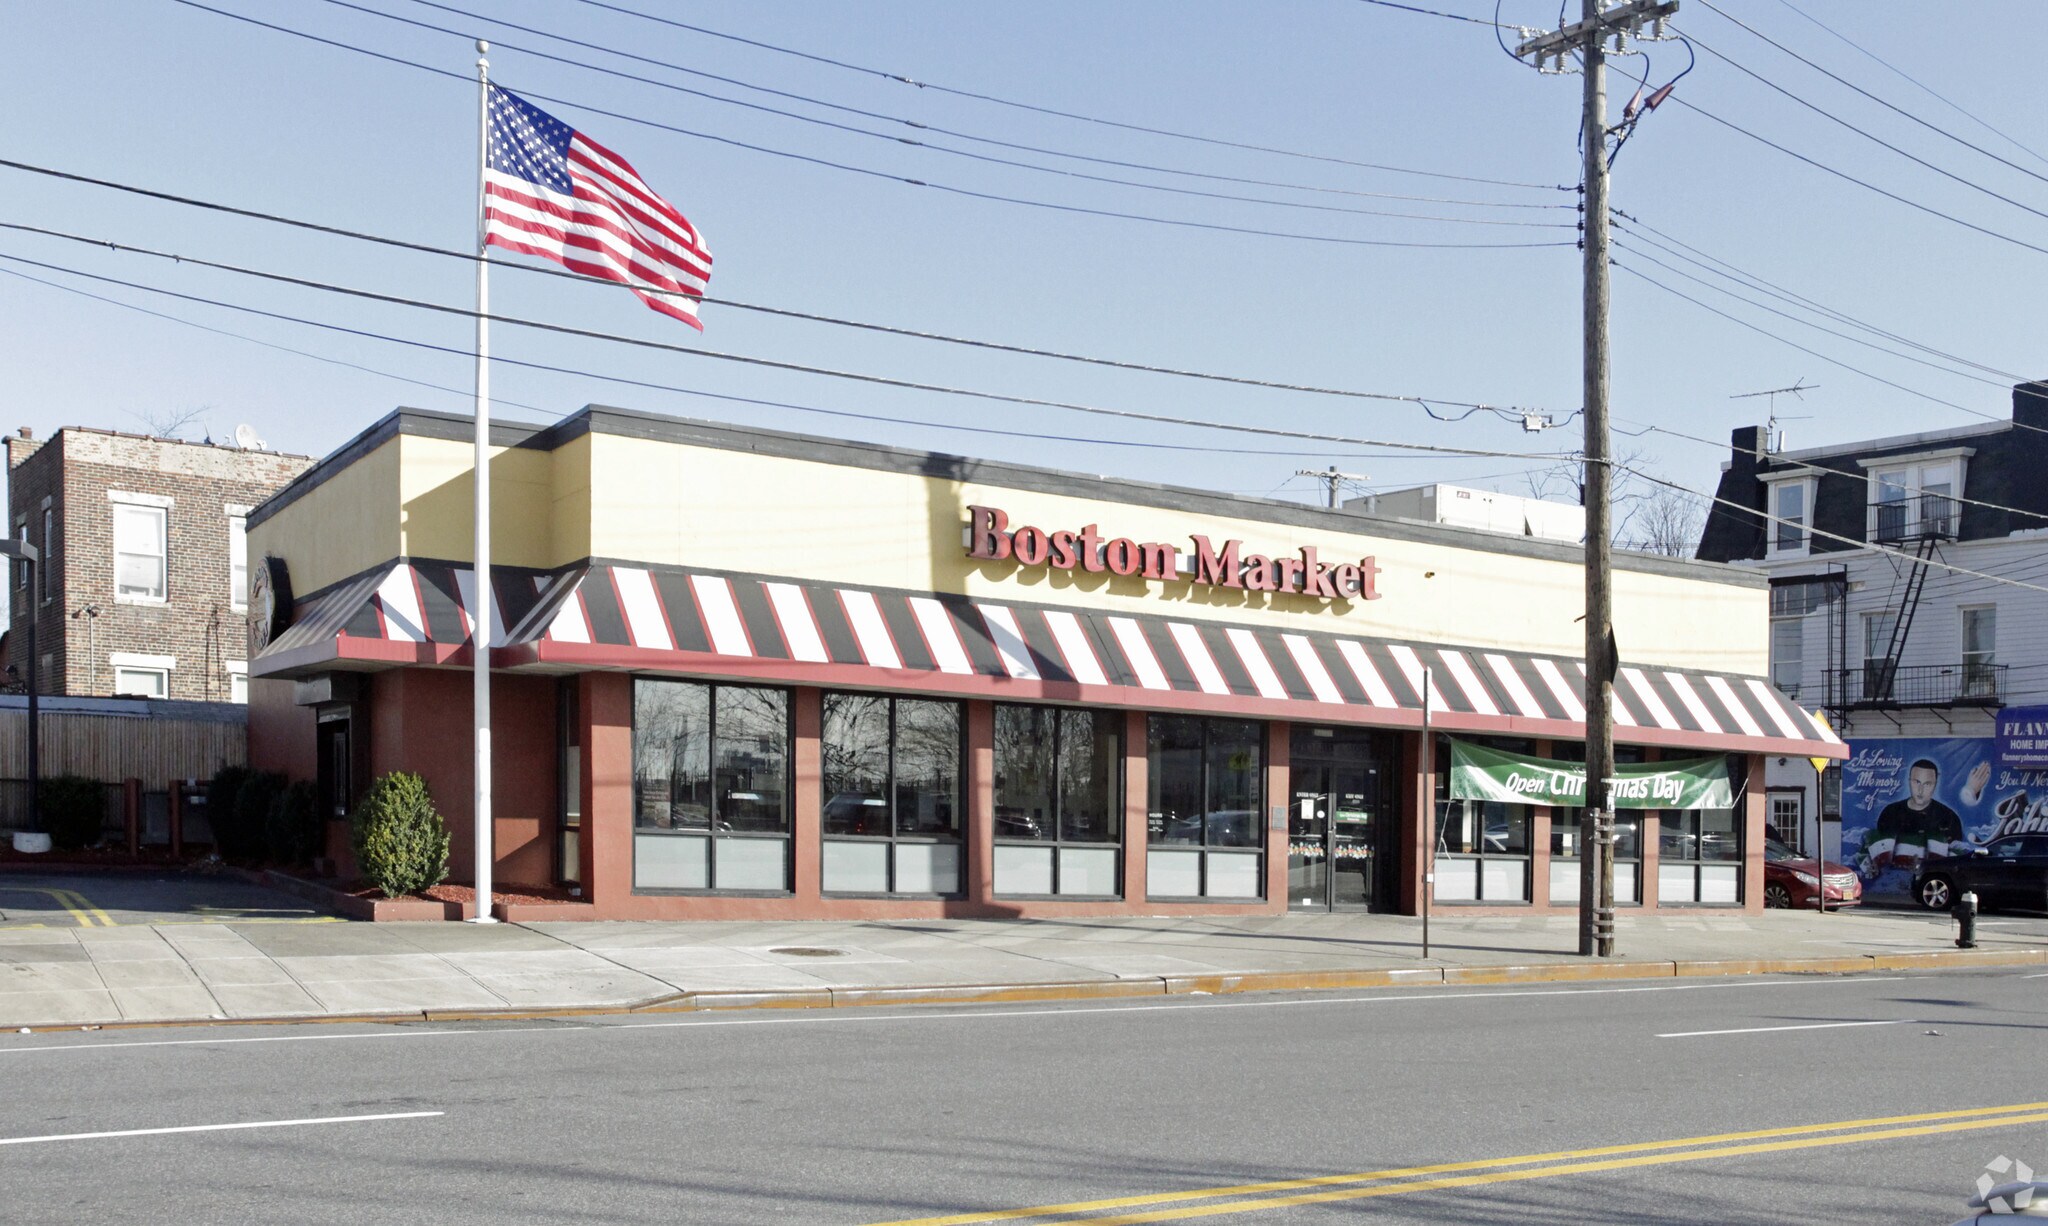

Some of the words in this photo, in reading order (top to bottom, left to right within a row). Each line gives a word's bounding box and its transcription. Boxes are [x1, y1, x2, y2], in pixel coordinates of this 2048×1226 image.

[965, 504, 1180, 581] Boston
[1189, 534, 1382, 601] Market
[2010, 739, 2033, 750] HOME
[1851, 748, 1868, 767] In
[1866, 748, 1903, 776] Loving
[1505, 772, 1546, 794] Open
[1550, 769, 1649, 799] Chrmas
[1652, 775, 1685, 805] Day
[1857, 771, 1901, 796] Memory
[1995, 771, 2031, 790] You'll
[1864, 788, 1879, 811] of
